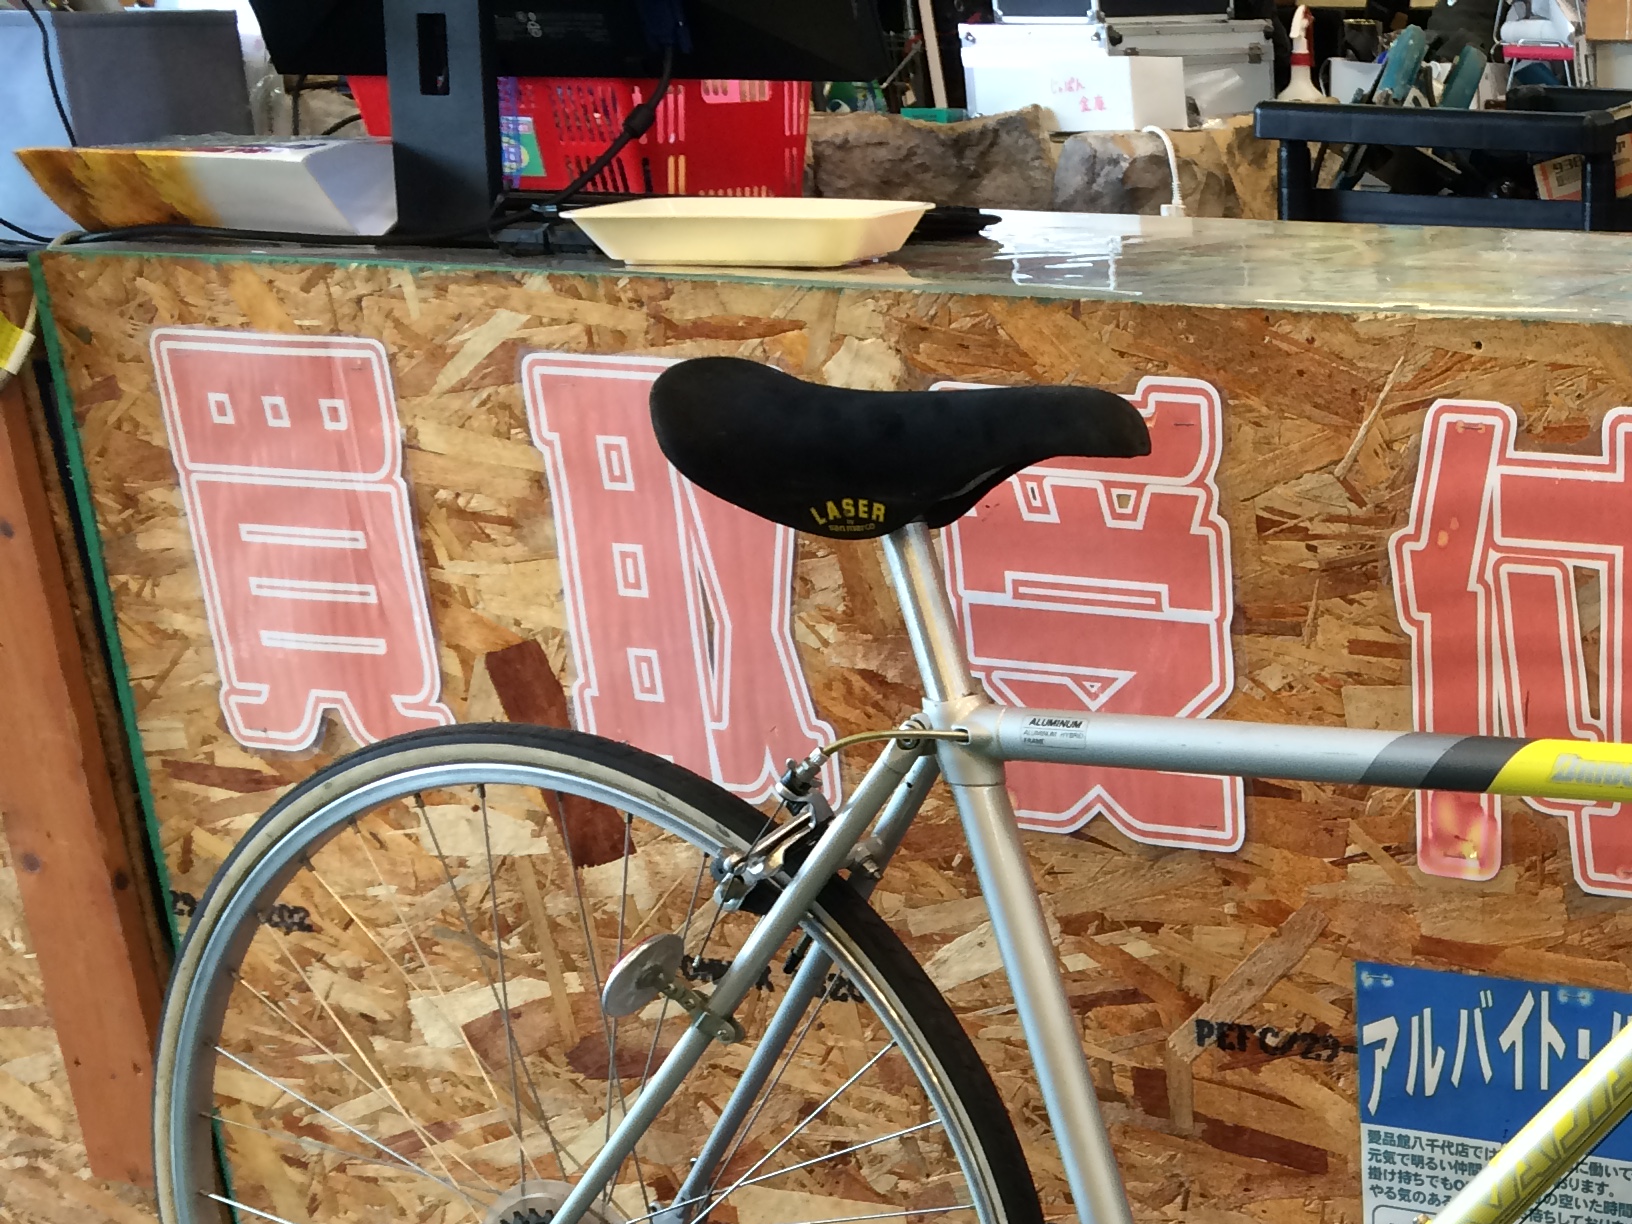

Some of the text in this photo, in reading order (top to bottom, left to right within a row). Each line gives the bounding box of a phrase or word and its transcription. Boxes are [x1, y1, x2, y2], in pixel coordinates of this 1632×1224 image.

[809, 497, 886, 526] LASER
[1028, 717, 1083, 729] ALUMINUM
[1367, 1165, 1470, 1192] 掛け持ちでもO
